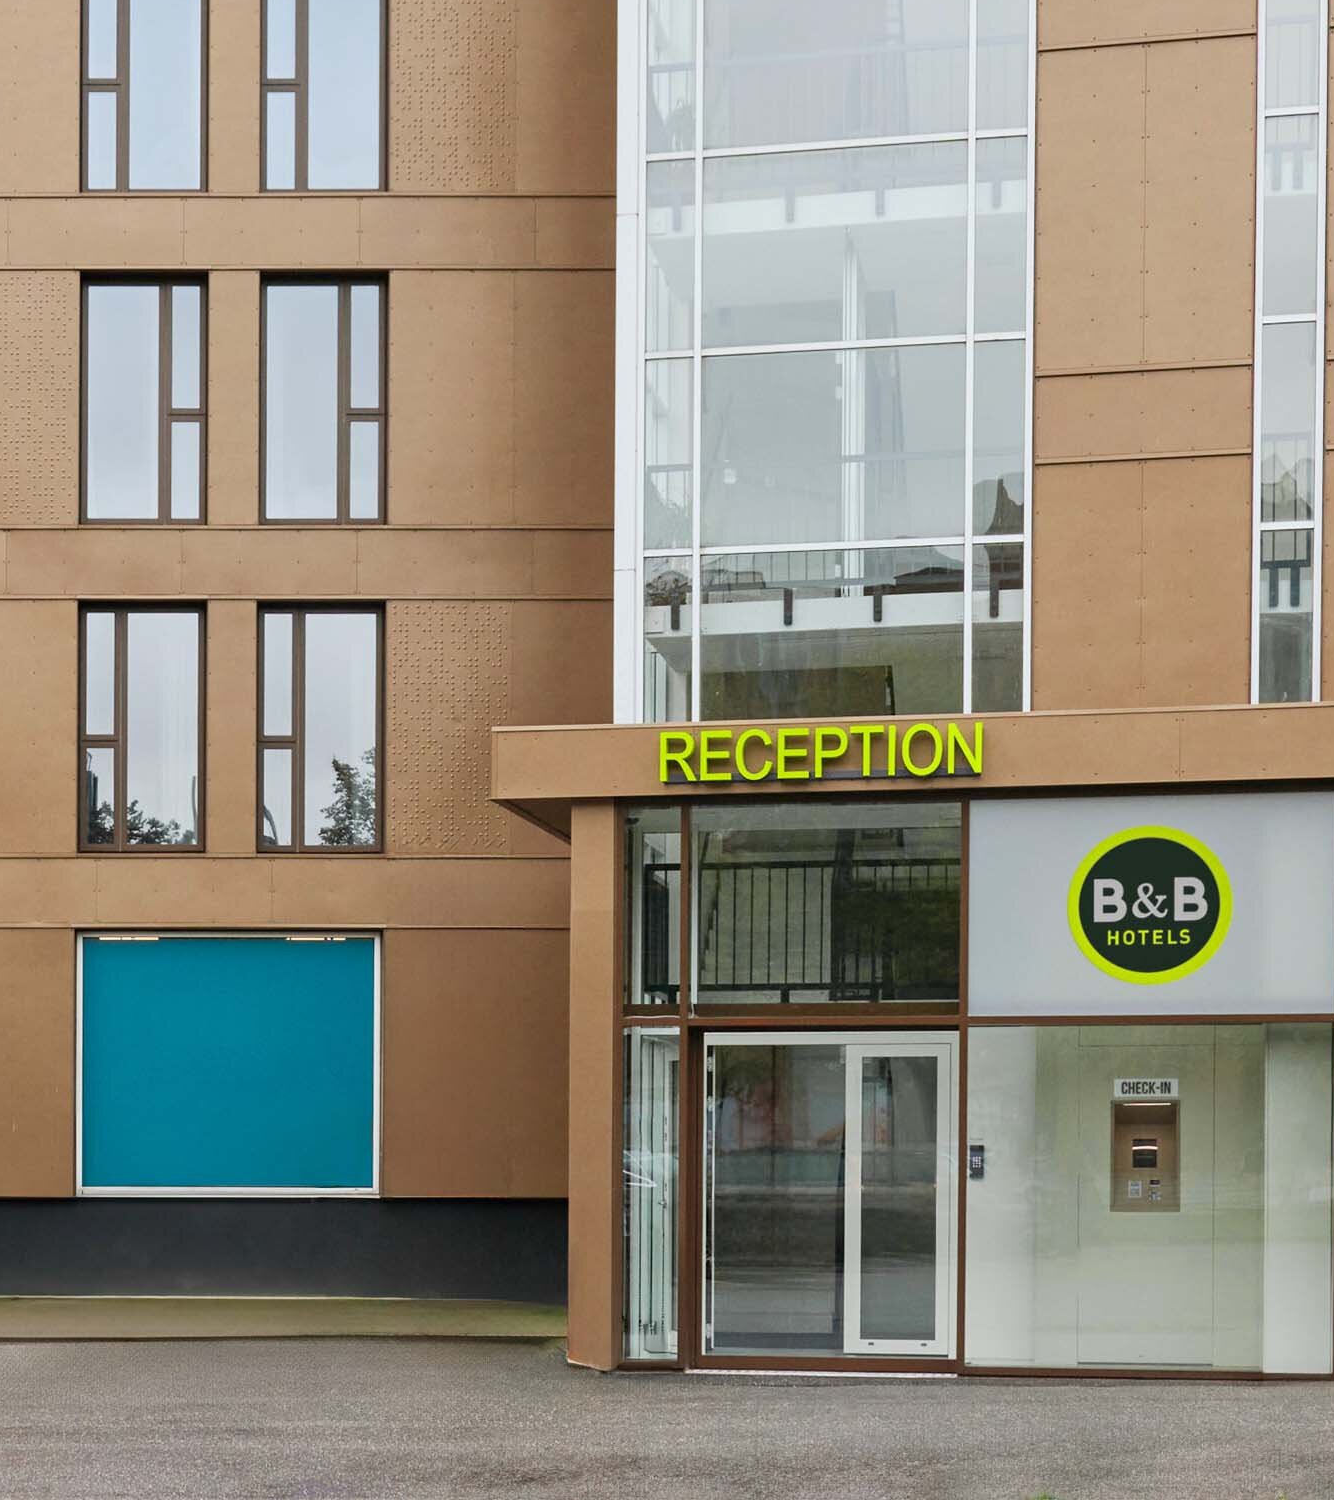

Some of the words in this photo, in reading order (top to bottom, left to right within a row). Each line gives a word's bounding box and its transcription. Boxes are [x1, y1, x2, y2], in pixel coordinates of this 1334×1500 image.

[659, 722, 984, 783] RECEPTION
[1093, 876, 1208, 923] B&B
[1107, 929, 1191, 946] HOTELS
[1121, 1081, 1171, 1095] CHECK-IN
